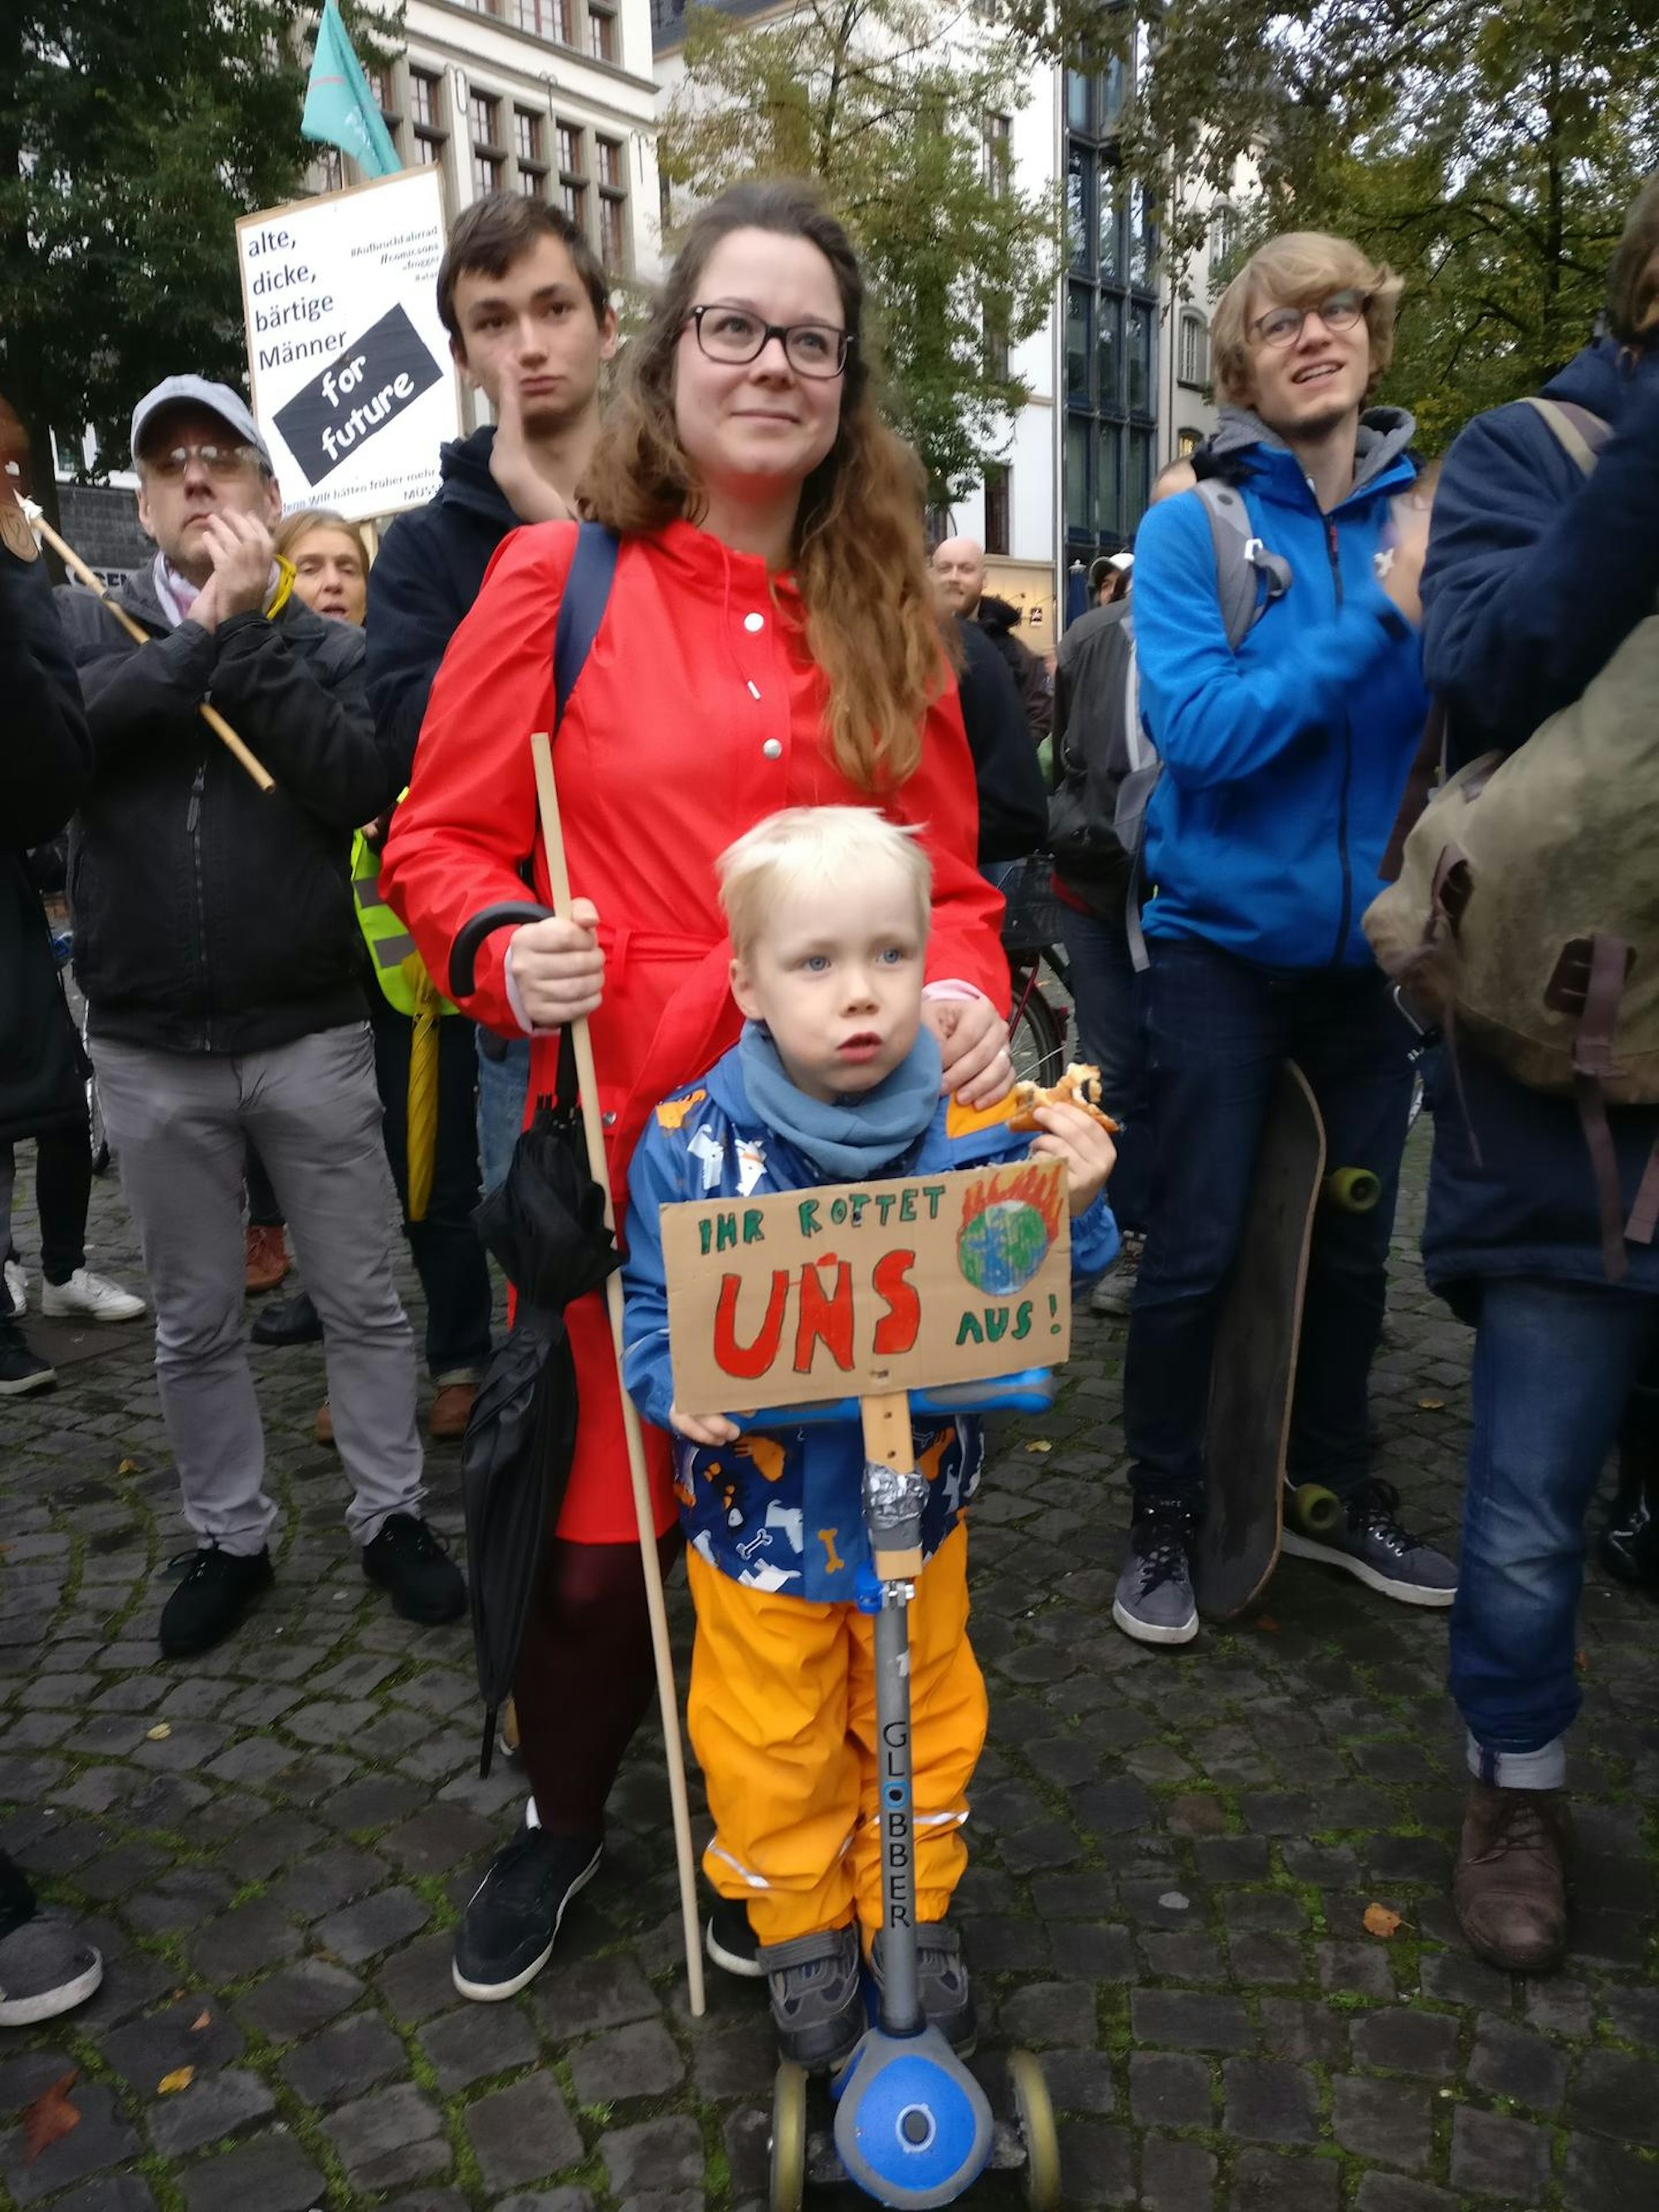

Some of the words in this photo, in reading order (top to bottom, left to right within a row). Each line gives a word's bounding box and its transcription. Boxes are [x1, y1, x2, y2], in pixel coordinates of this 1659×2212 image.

[248, 230, 296, 258] alte,
[252, 265, 316, 296] dicke,
[255, 294, 334, 334] bärtige
[259, 331, 348, 373] Männer
[320, 354, 368, 408] for
[320, 371, 415, 461] future
[698, 1209, 765, 1255] IHR
[798, 1184, 947, 1237] ROTTET
[713, 1249, 922, 1380] UNS
[882, 1721, 912, 1929] GLOBBER
